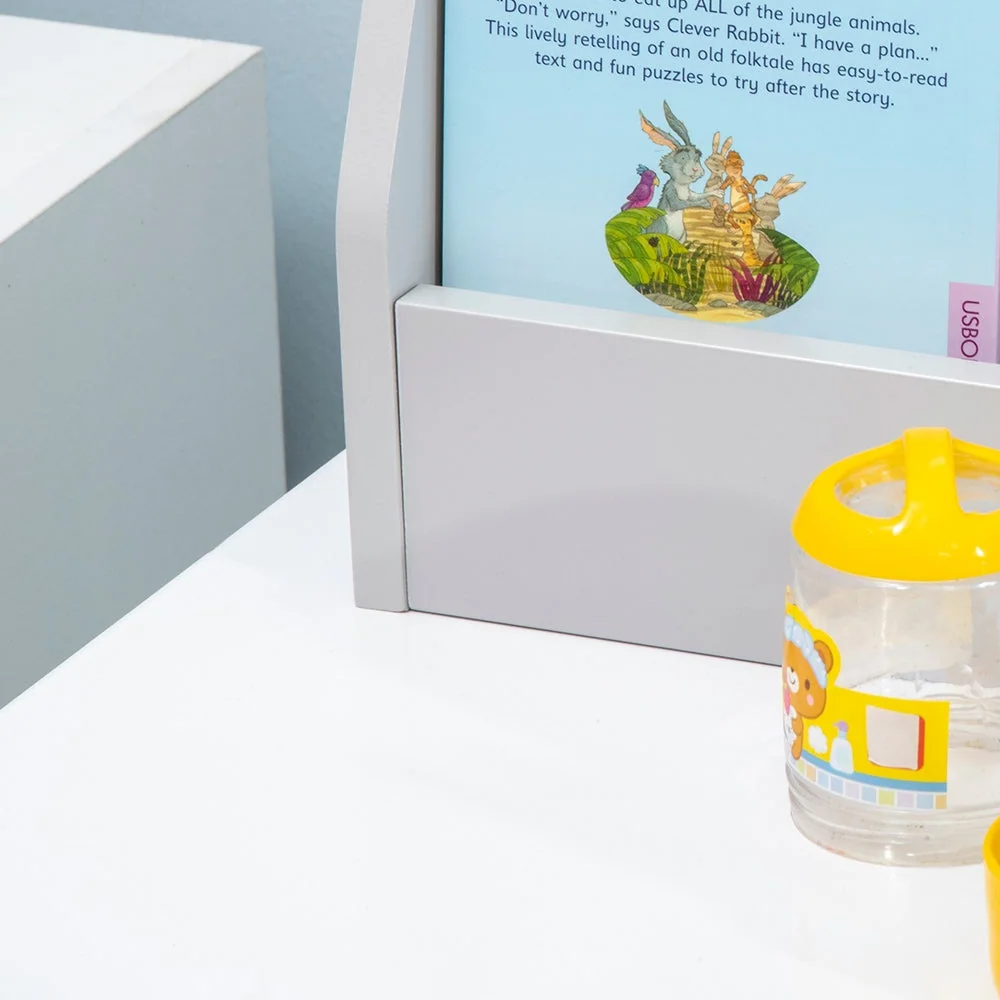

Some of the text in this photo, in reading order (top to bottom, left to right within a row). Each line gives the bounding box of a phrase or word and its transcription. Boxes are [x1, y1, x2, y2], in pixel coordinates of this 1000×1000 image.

[624, 17, 660, 33] says
[667, 18, 720, 37] Clever
[815, 34, 853, 52] have
[861, 44, 870, 54] a
[734, 2, 751, 16] of
[757, 4, 783, 20] the
[788, 7, 841, 29] jungle
[485, 19, 947, 87] This lively retelling of an old folktale has easy-to-read
[535, 52, 566, 67] text
[573, 58, 602, 72] and
[610, 59, 635, 76] fun
[643, 68, 703, 84] puzzles
[711, 73, 727, 87] to
[735, 76, 758, 94] try
[766, 79, 806, 95] after
[813, 84, 839, 100] the
[961, 300, 980, 361] USBO
